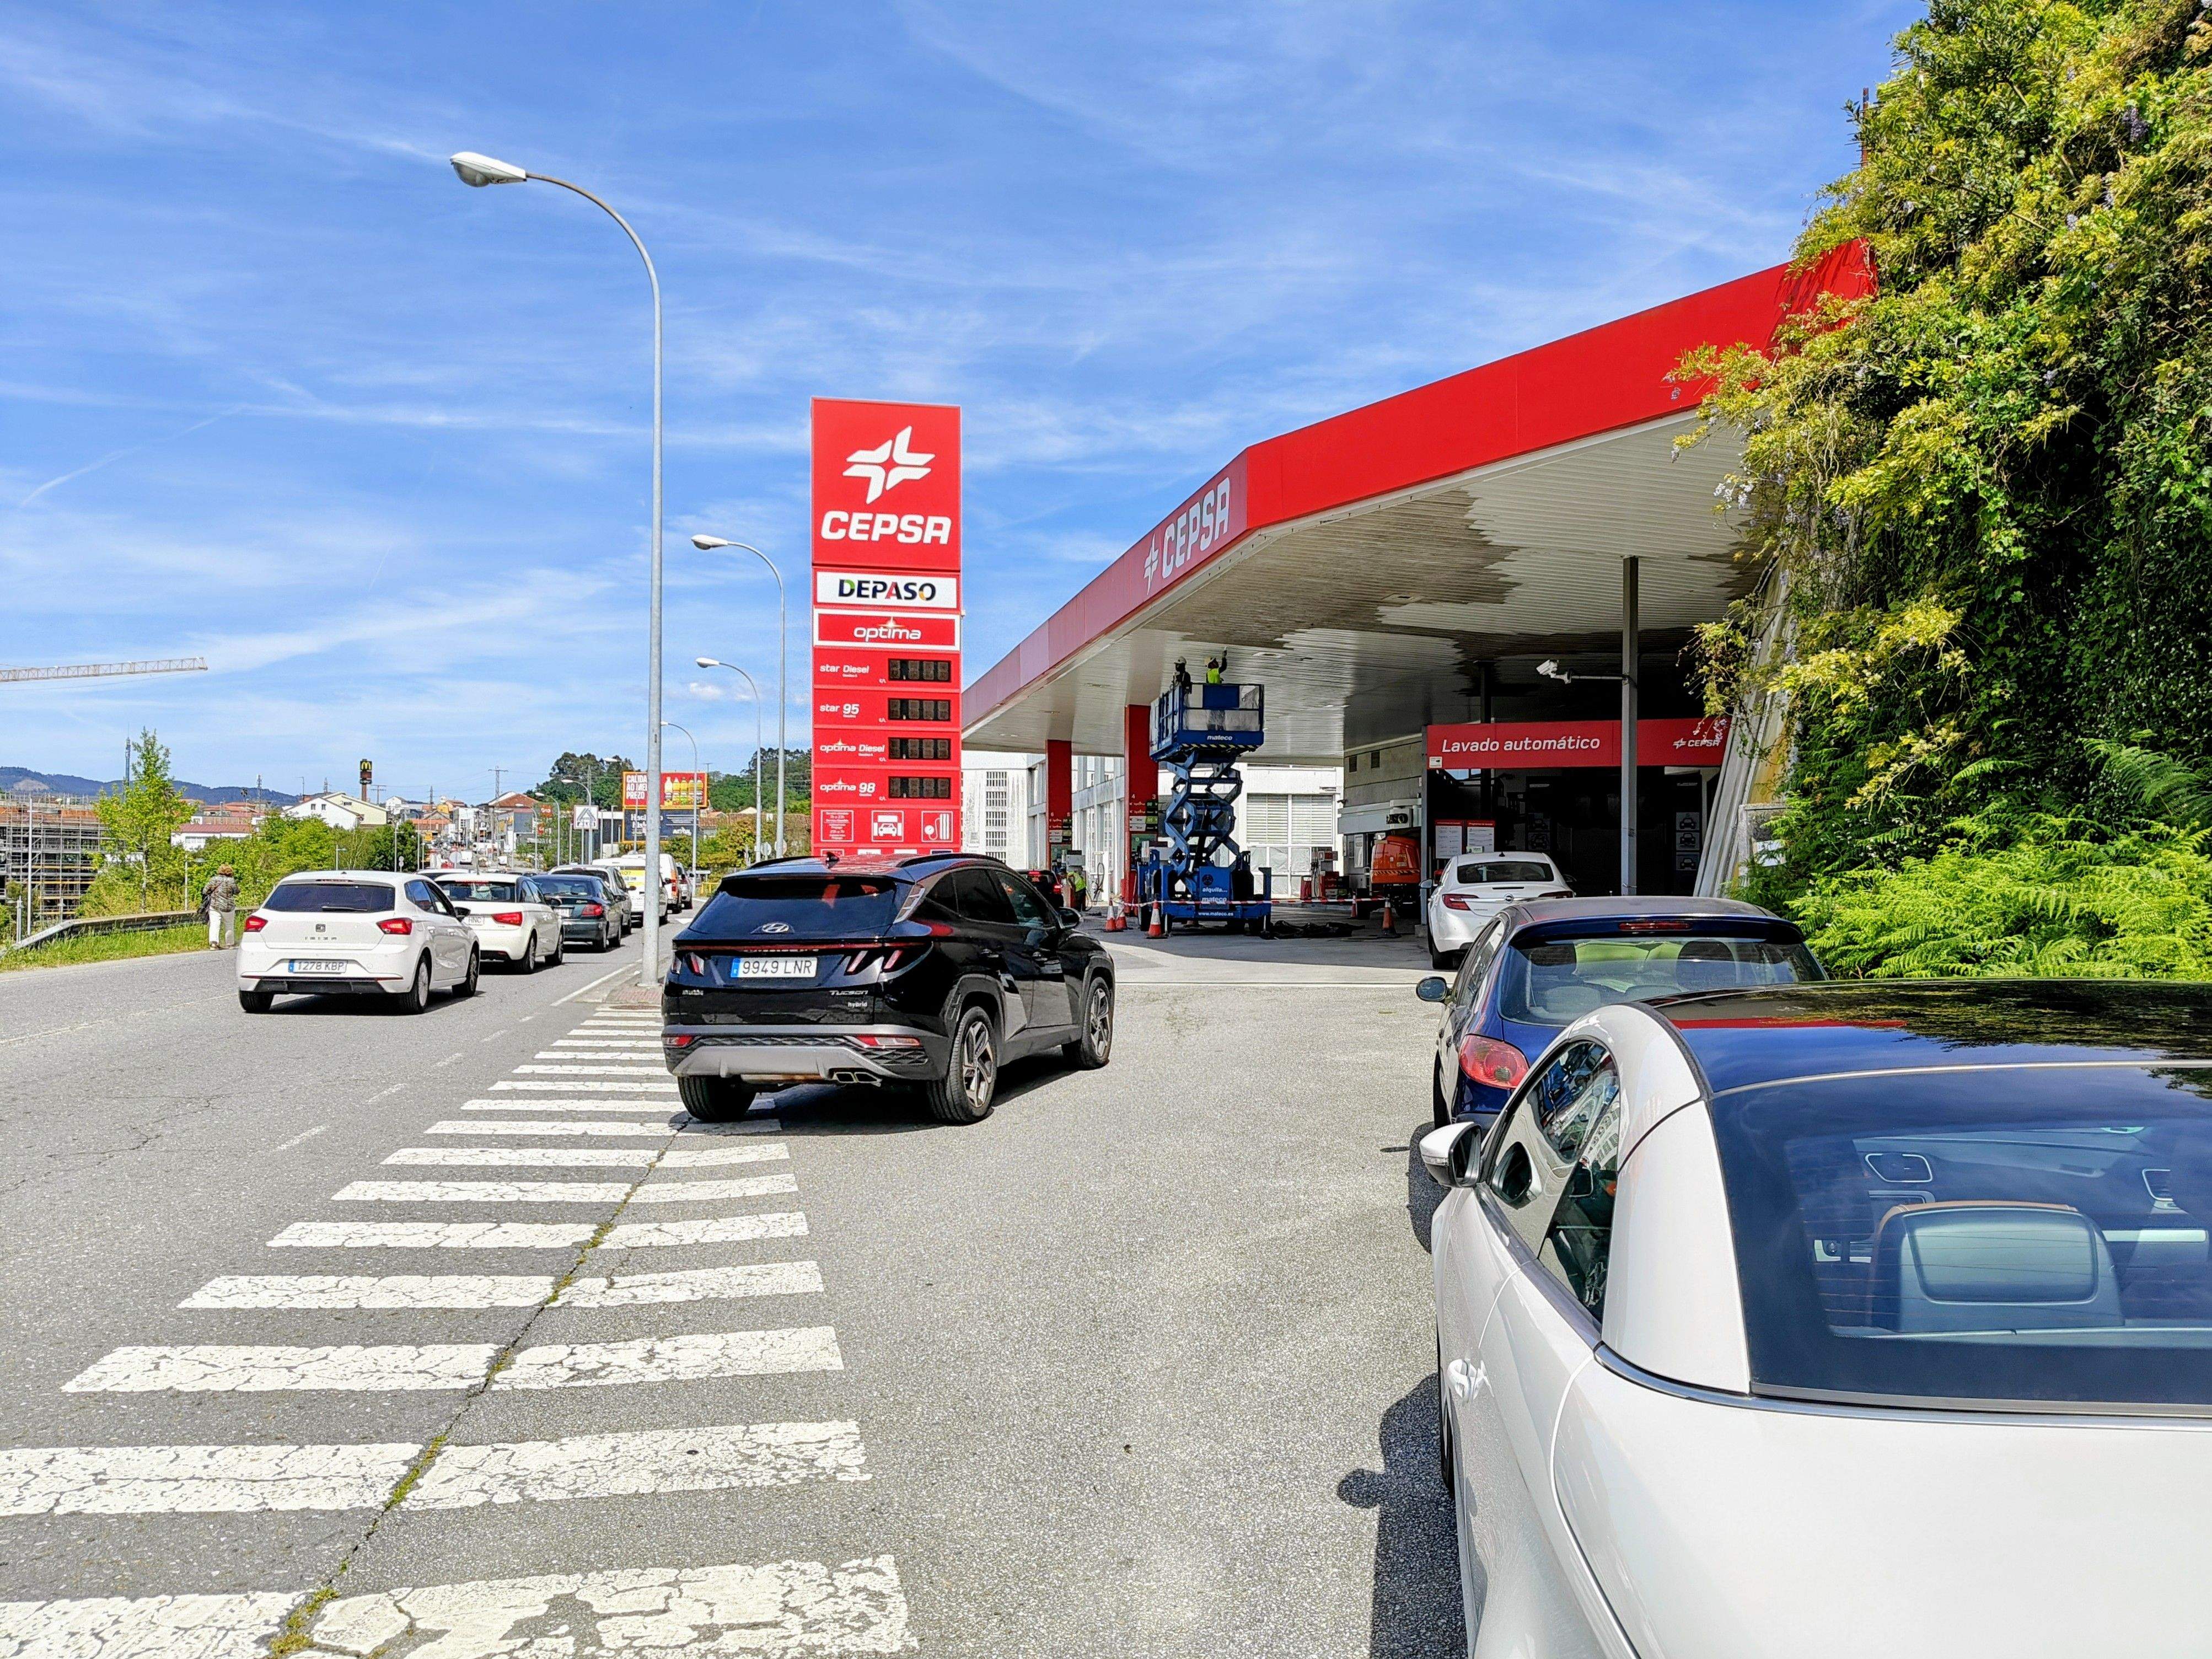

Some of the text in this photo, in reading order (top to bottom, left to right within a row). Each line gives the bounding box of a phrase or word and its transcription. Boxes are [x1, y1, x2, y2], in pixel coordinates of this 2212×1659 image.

[821, 510, 952, 545] CEPSA
[1162, 477, 1230, 579] CEPSA
[838, 578, 936, 602] DEPASO
[853, 625, 922, 642] optima
[819, 664, 870, 673] star Diesel
[842, 703, 860, 715] 95
[820, 743, 885, 753] optima Diesel
[1442, 735, 1600, 753] Lavado automático
[820, 782, 876, 793] optima 98
[298, 962, 344, 970] 1278 KBP
[743, 960, 812, 974] 9949 LNR
